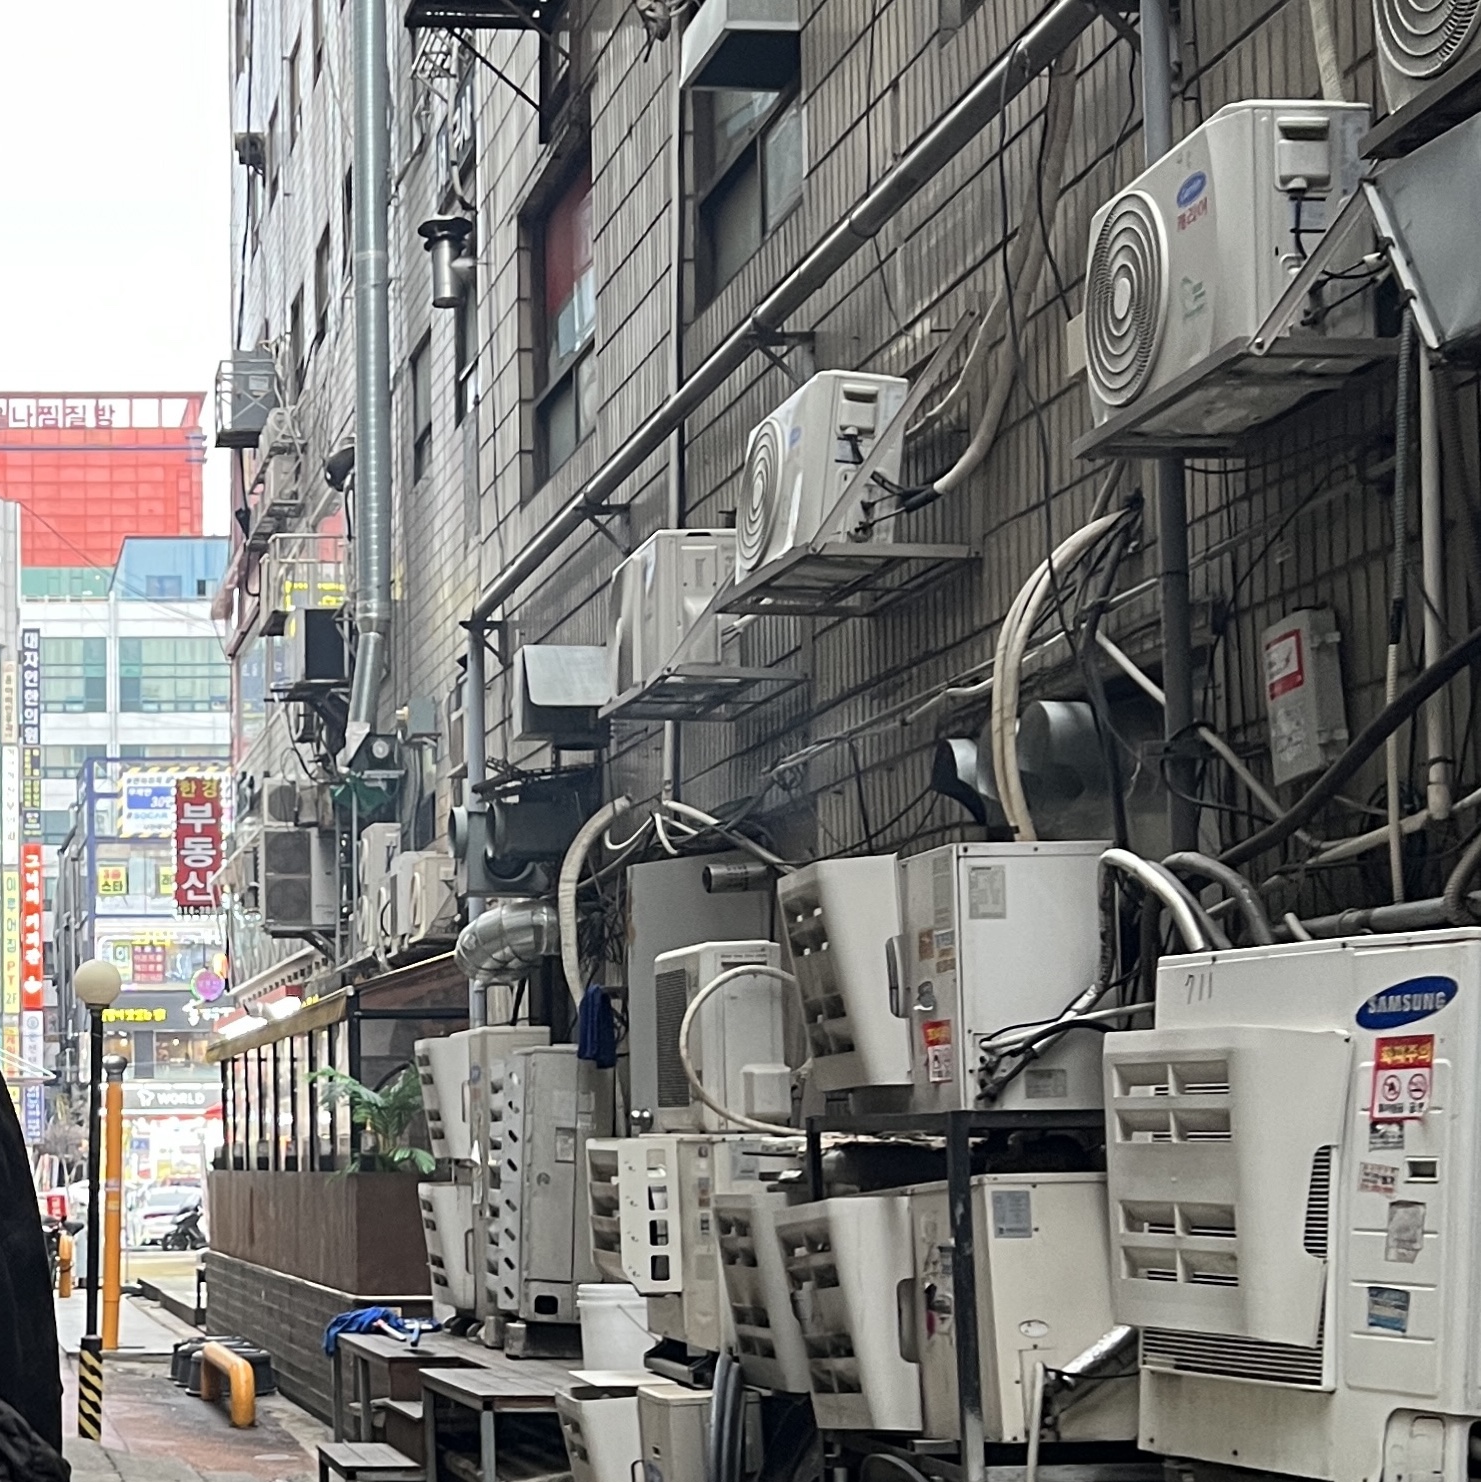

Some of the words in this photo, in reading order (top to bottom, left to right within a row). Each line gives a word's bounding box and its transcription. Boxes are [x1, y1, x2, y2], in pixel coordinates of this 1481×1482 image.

[179, 802, 218, 905] 부동산
[1367, 991, 1447, 1014] SAMSUNG
[156, 1092, 206, 1105] WORLD
